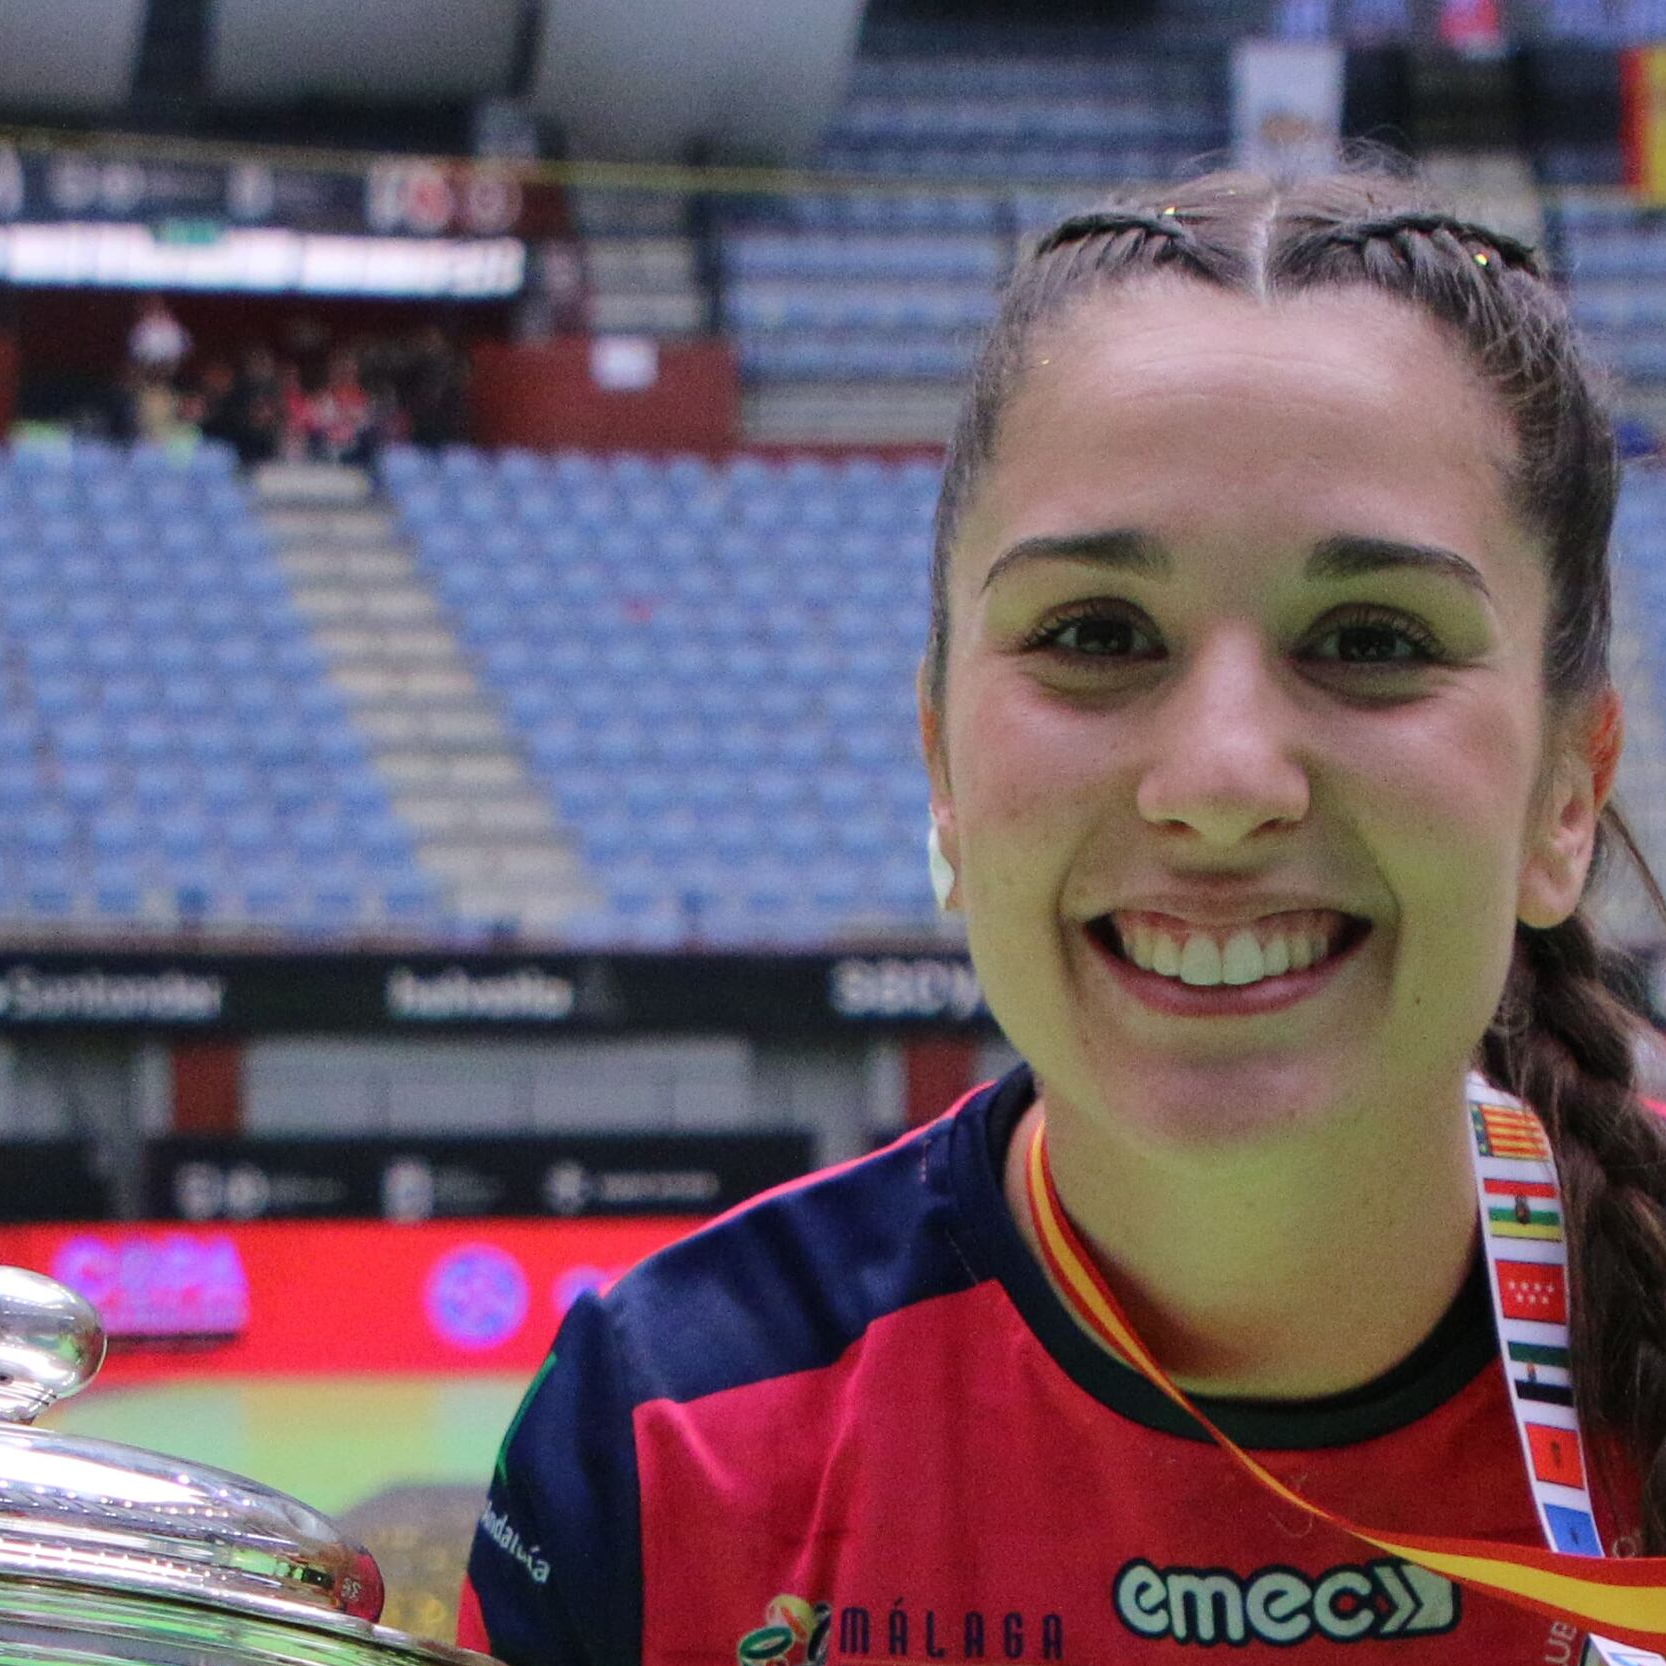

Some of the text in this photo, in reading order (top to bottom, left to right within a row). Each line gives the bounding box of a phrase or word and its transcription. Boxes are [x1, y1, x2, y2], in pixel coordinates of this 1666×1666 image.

[9, 968, 225, 1019] Santander
[839, 1597, 1065, 1661] MÁLAGA
[1113, 1558, 1381, 1646] emec
